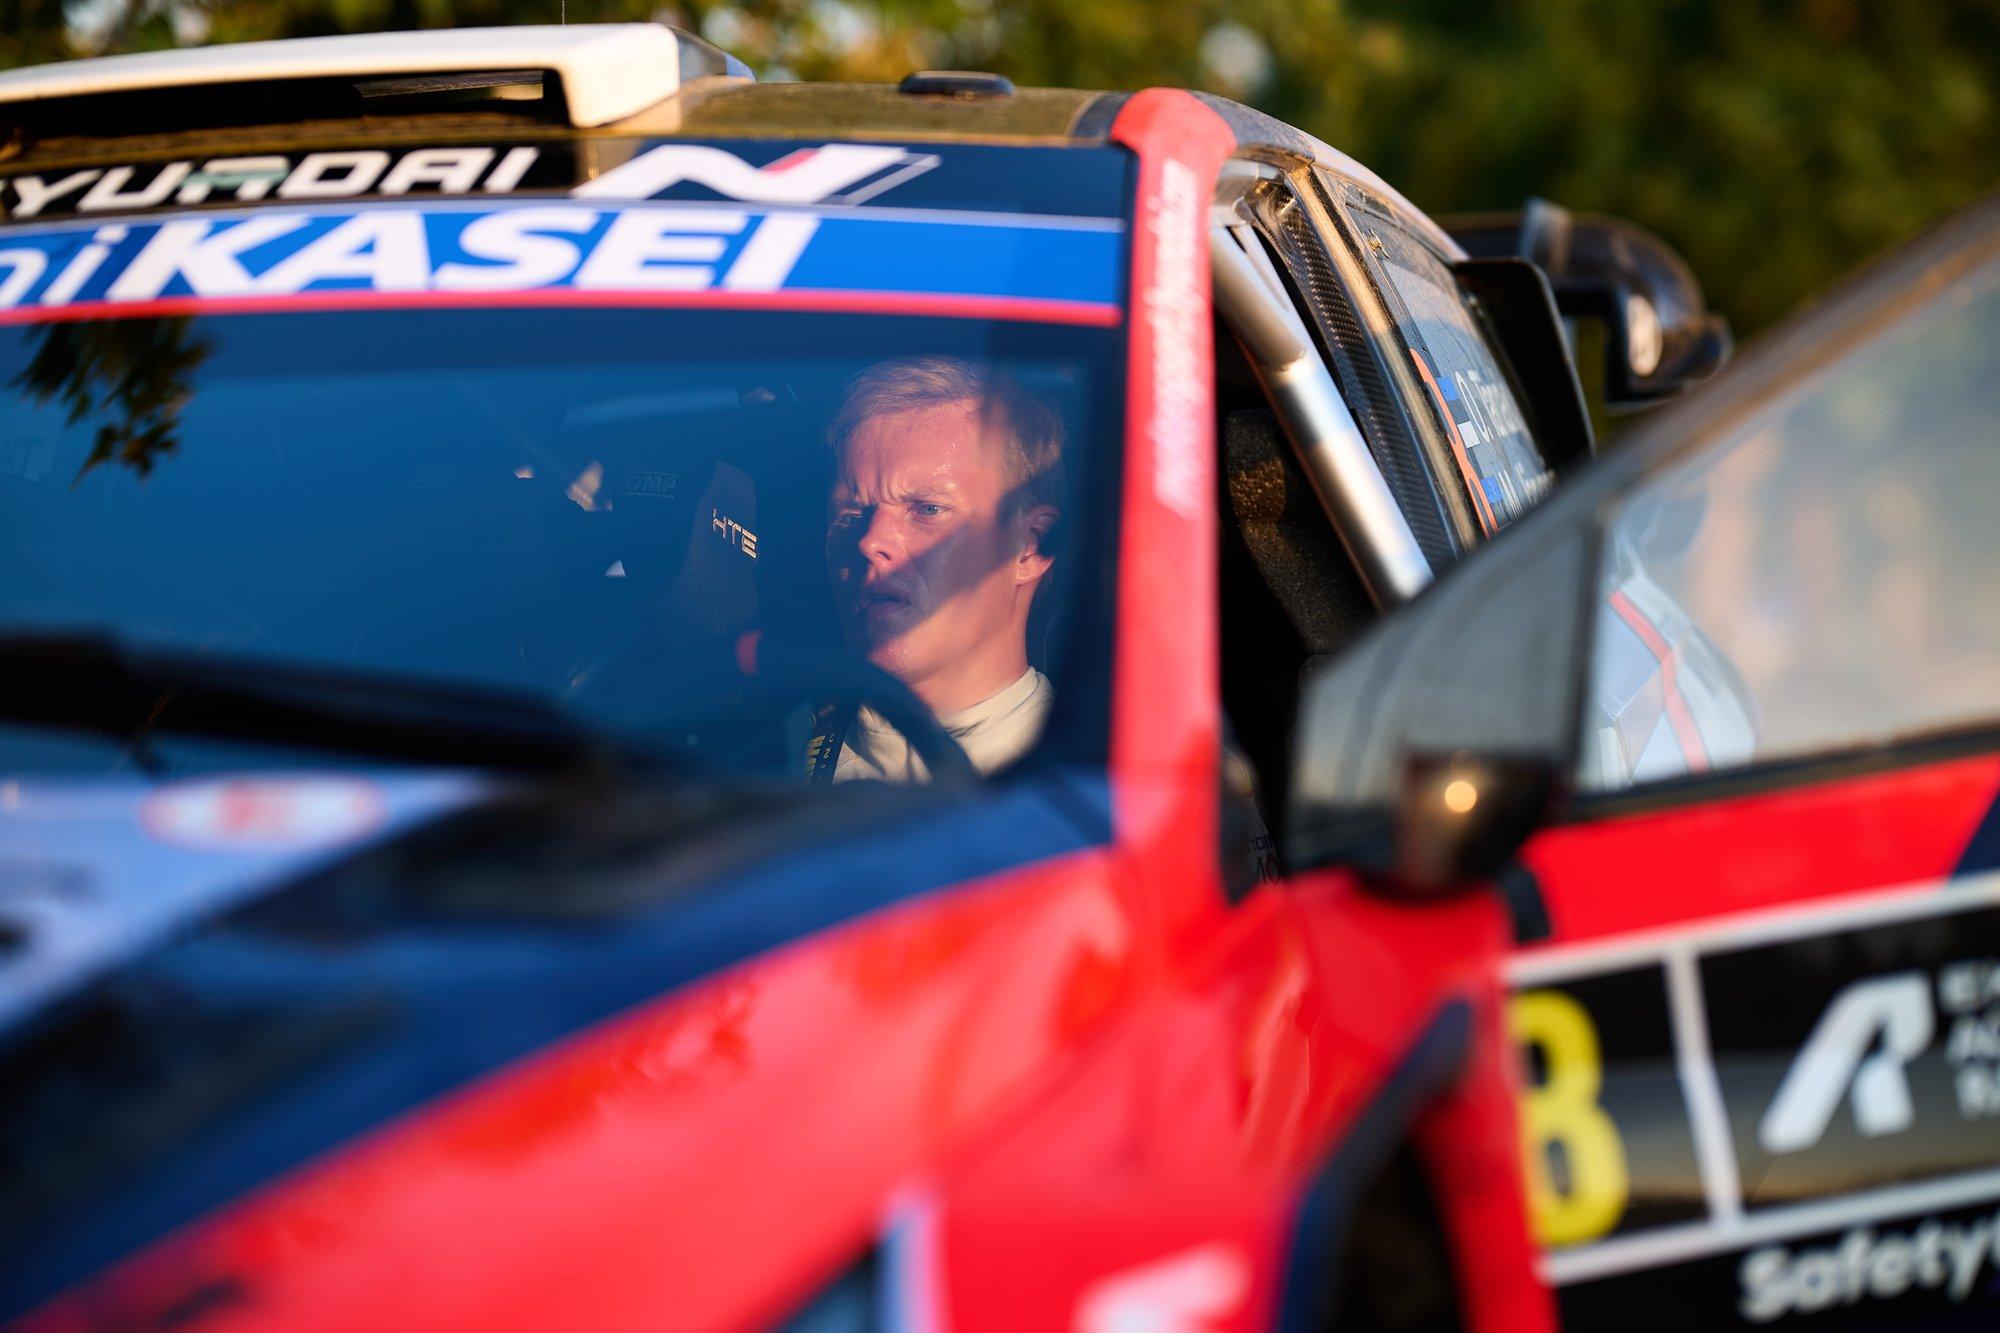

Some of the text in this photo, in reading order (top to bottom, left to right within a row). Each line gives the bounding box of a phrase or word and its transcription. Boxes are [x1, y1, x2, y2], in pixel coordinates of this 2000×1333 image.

[0, 146, 540, 219] YUNDAI
[625, 473, 677, 495] OMP
[711, 506, 757, 559] HTE
[1508, 988, 1630, 1248] 8
[1738, 1212, 2000, 1323] Safety
